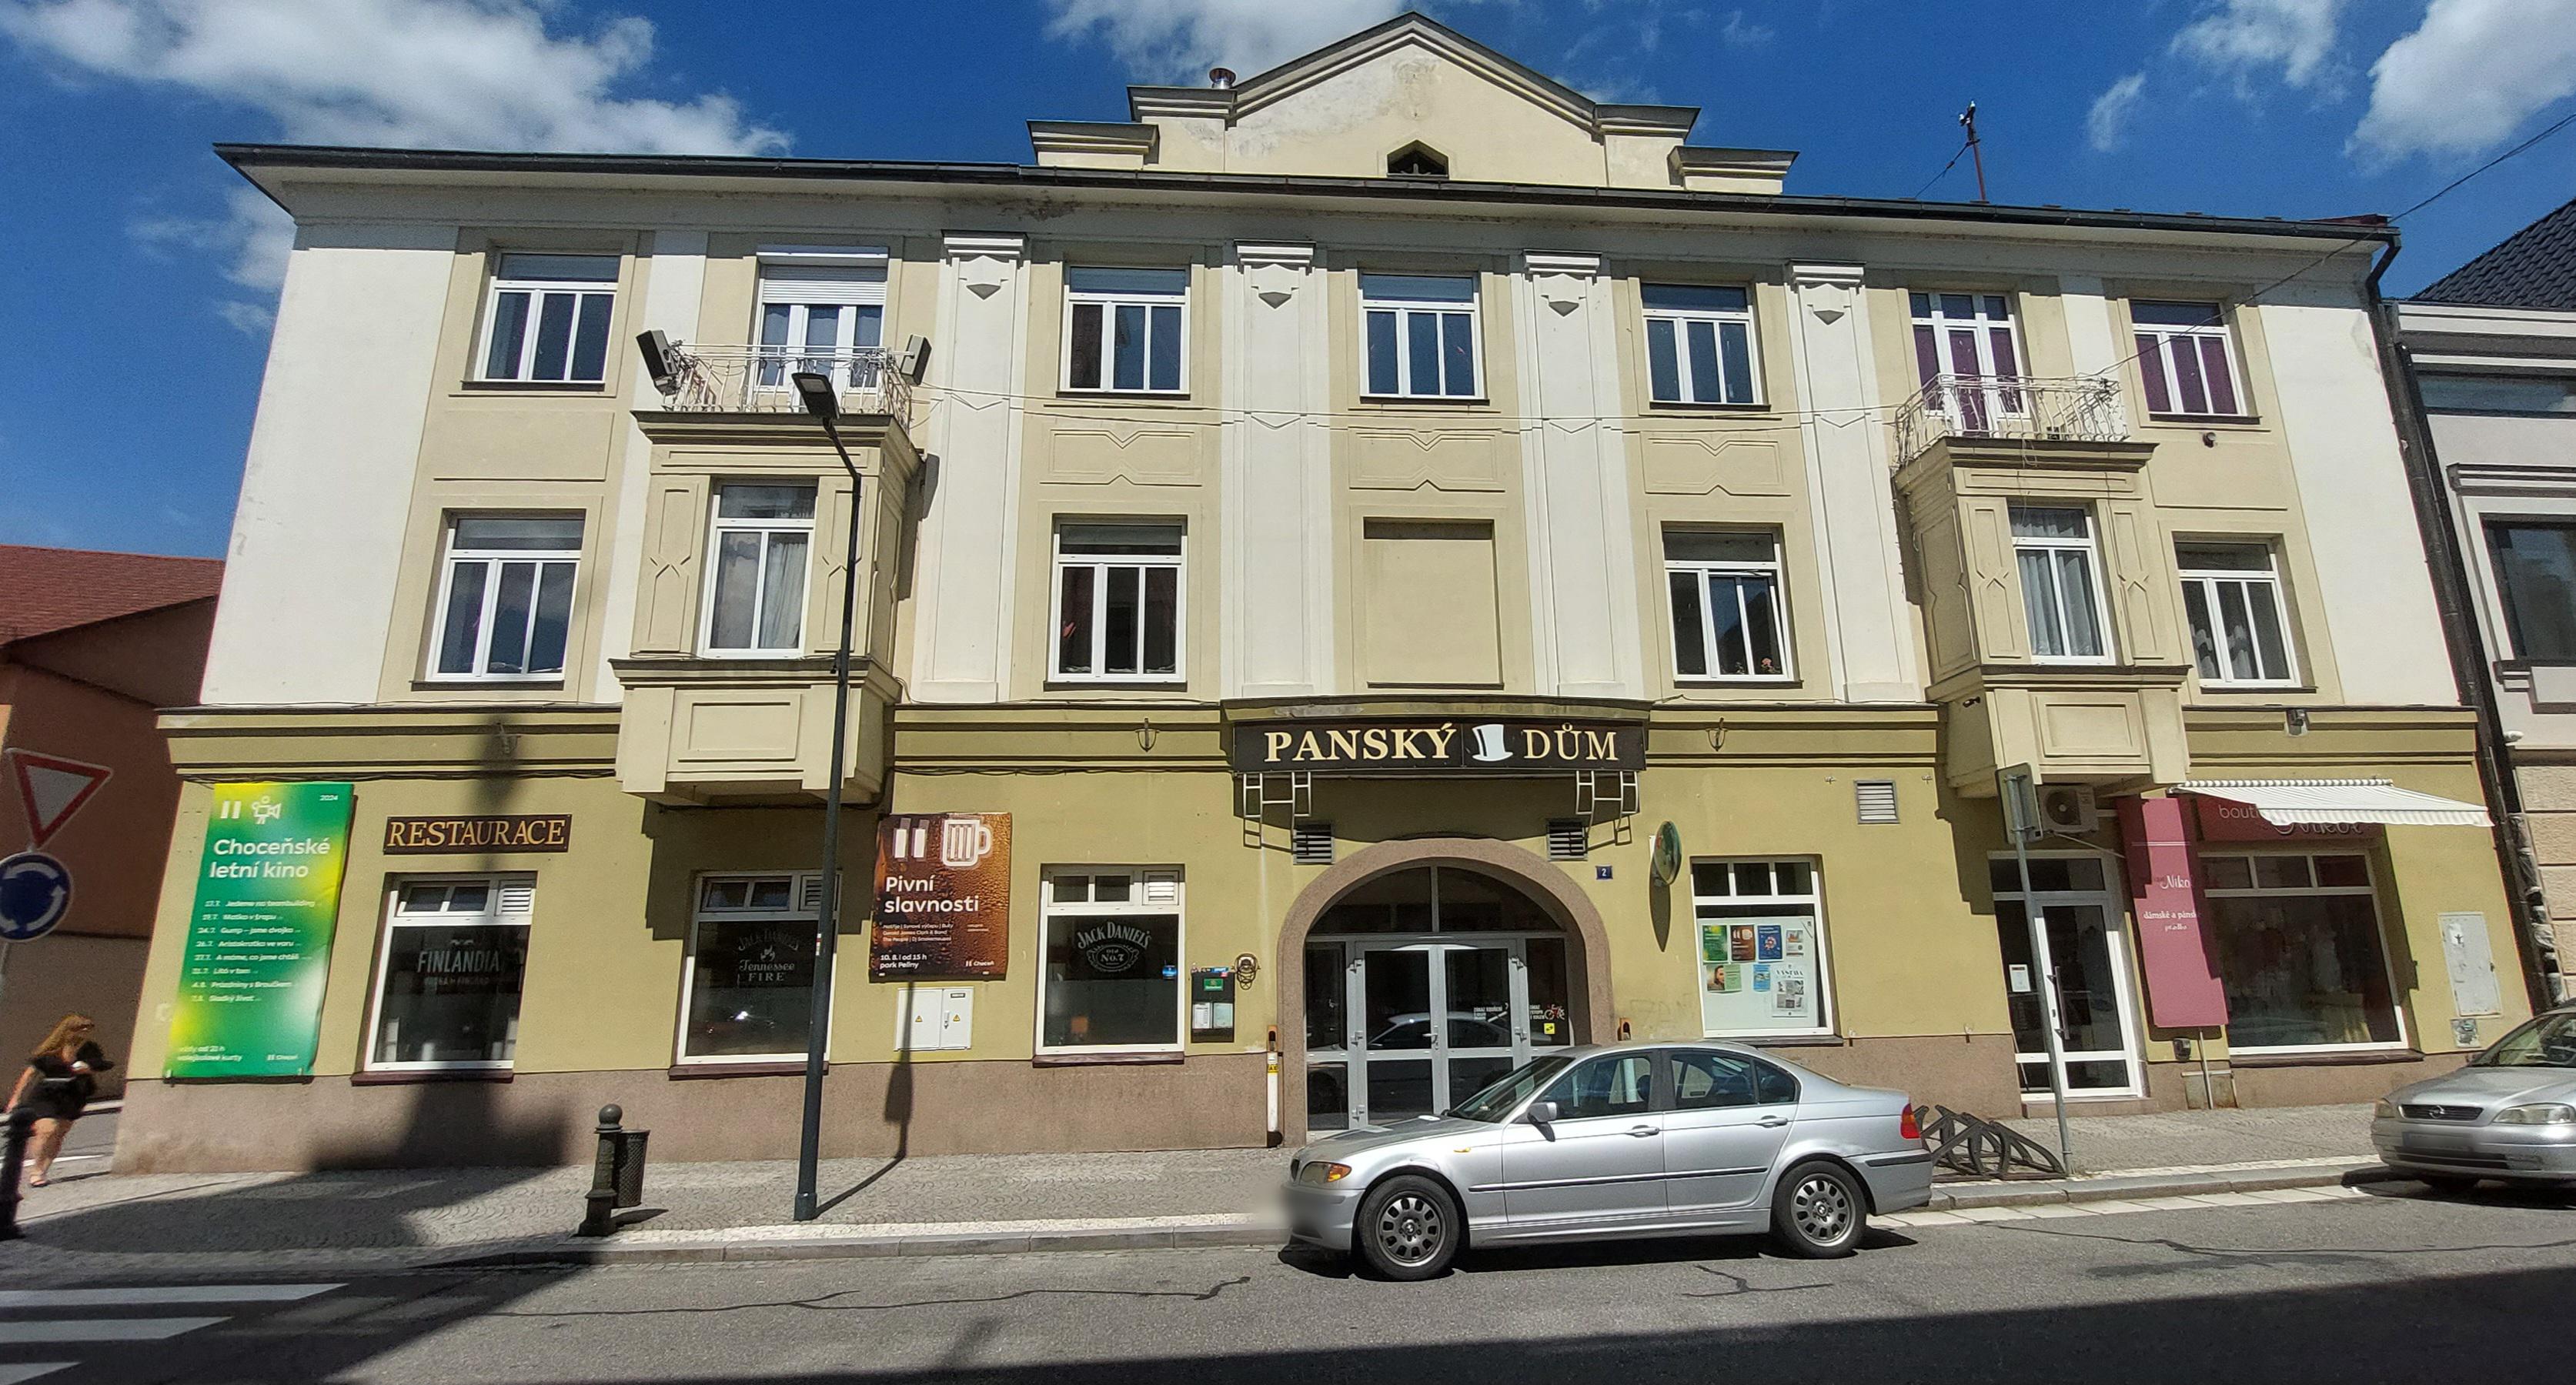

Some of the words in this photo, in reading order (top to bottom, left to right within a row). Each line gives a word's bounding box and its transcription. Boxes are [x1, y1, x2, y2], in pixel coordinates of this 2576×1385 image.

[1264, 723, 1458, 763] PANSKÝ
[1522, 723, 1619, 762] DŮM
[2219, 804, 2260, 819] bouti
[386, 819, 566, 847] RESTAURACE
[213, 837, 331, 855] Choceňské
[209, 861, 260, 878] letní
[262, 861, 309, 878] kino
[1602, 868, 1607, 876] 2
[886, 874, 936, 892] Pivní
[884, 895, 980, 913] slavnosti
[1077, 926, 1106, 949] JACK
[416, 950, 499, 973] FINLANDIA
[739, 959, 795, 971] Tennessee
[748, 972, 785, 982] FIRE
